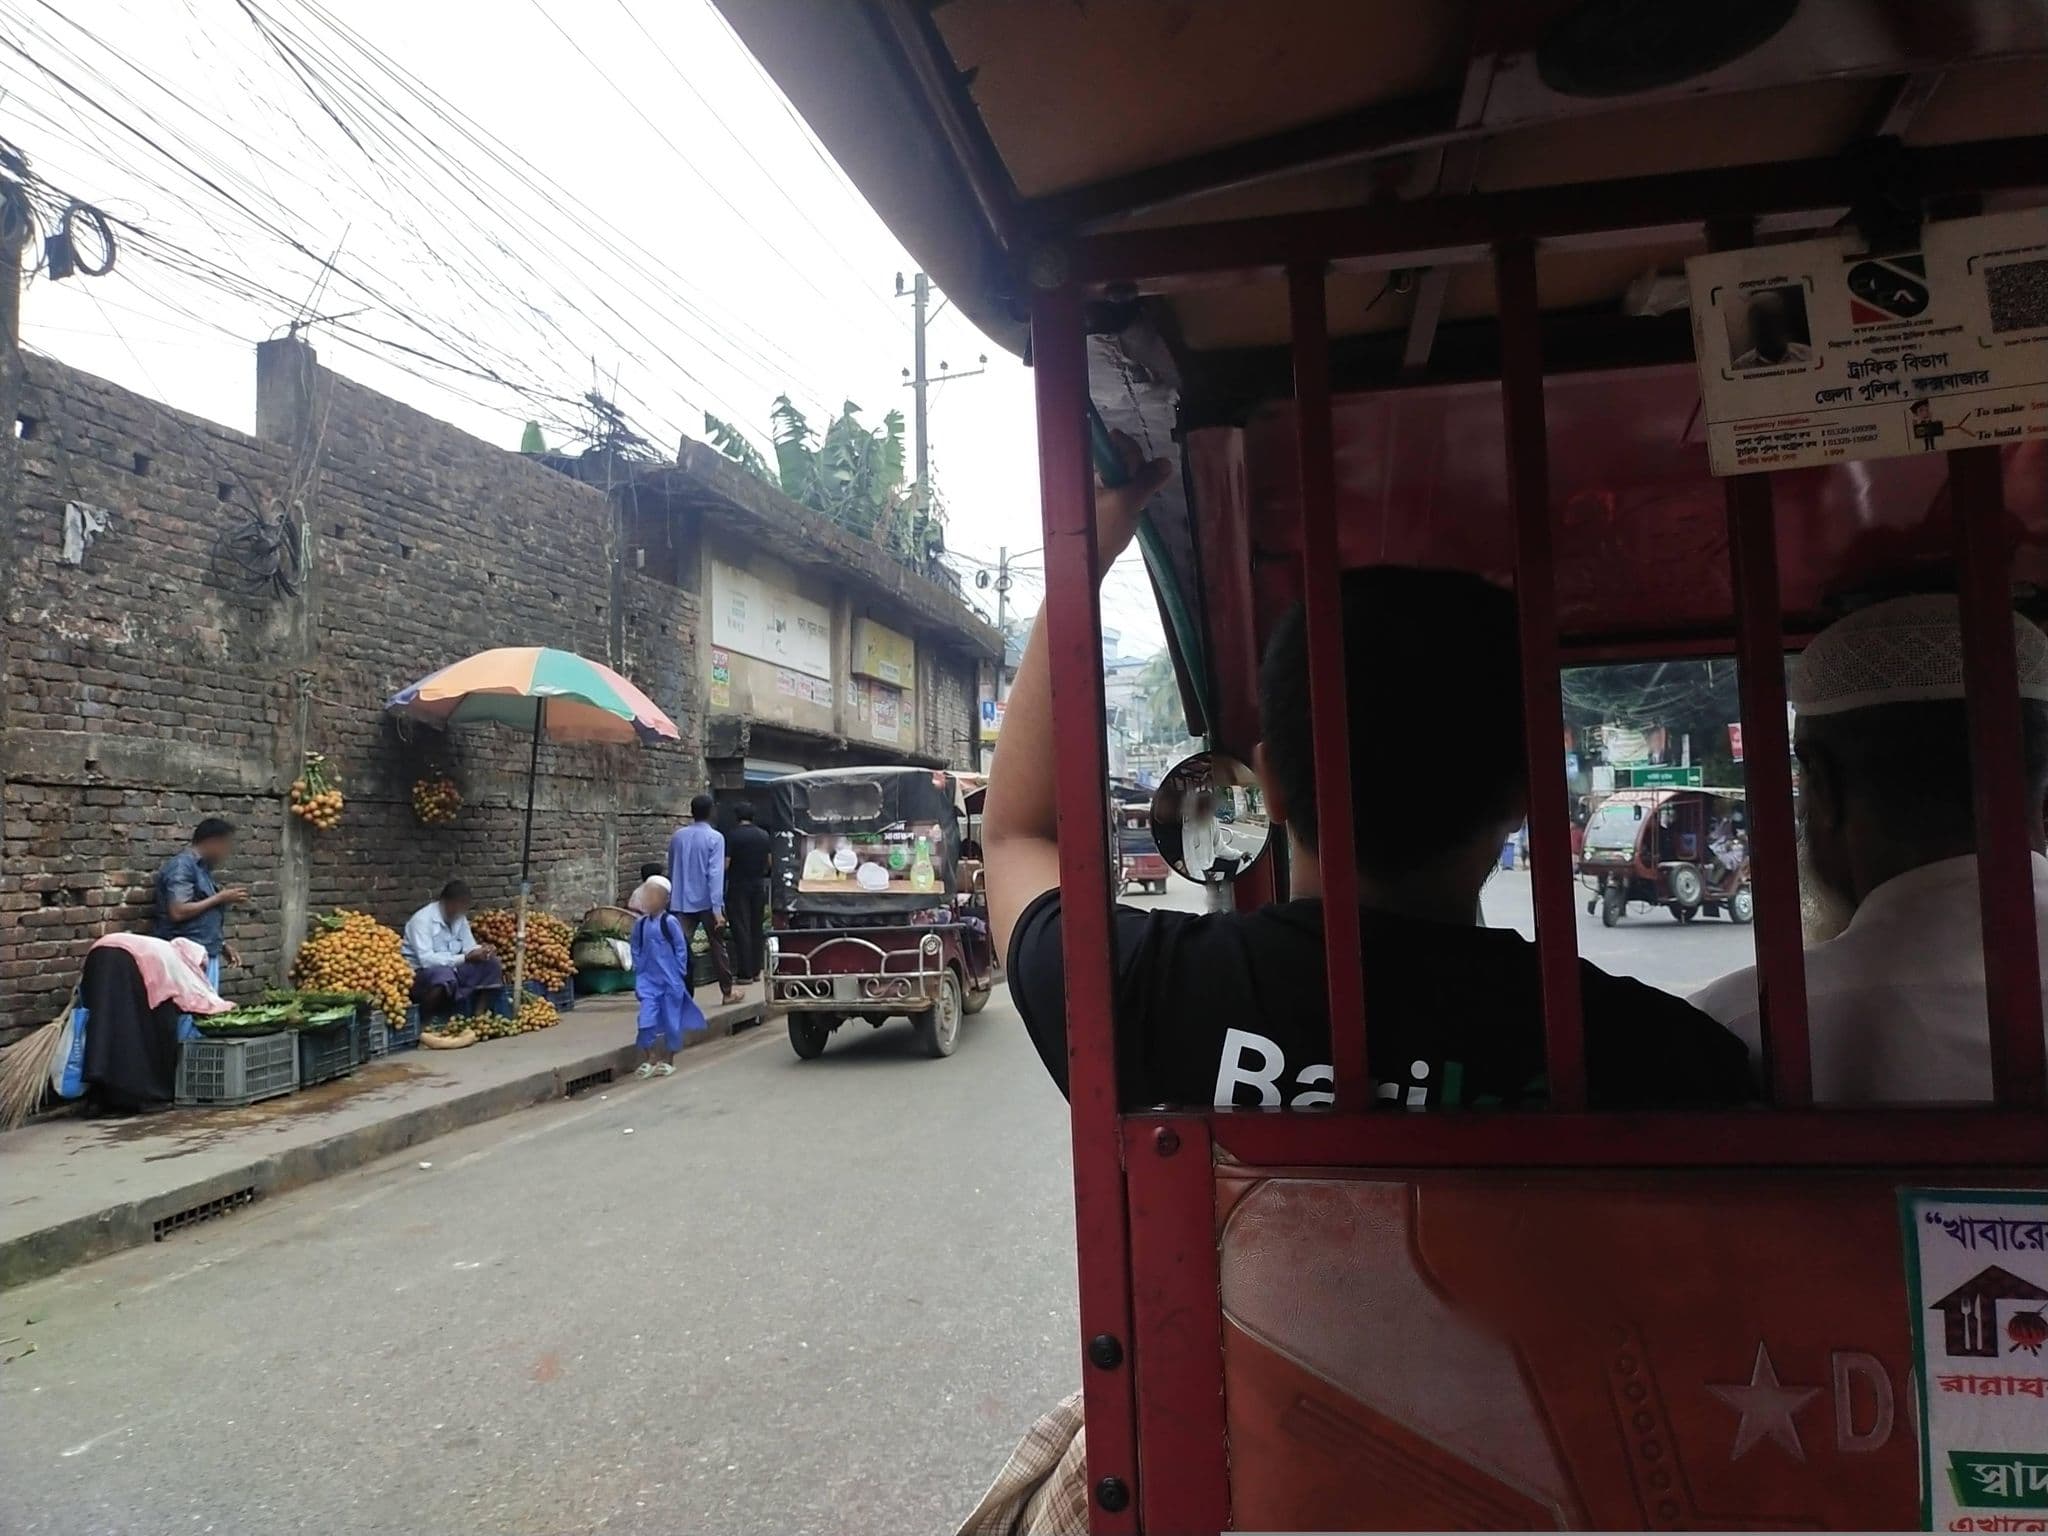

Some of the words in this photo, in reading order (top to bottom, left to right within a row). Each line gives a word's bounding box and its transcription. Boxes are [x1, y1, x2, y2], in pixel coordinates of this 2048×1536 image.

[1847, 357, 1898, 379] ট্রাফিক
[1901, 352, 1949, 373] বিভাগ
[1814, 386, 1853, 404] জেলা
